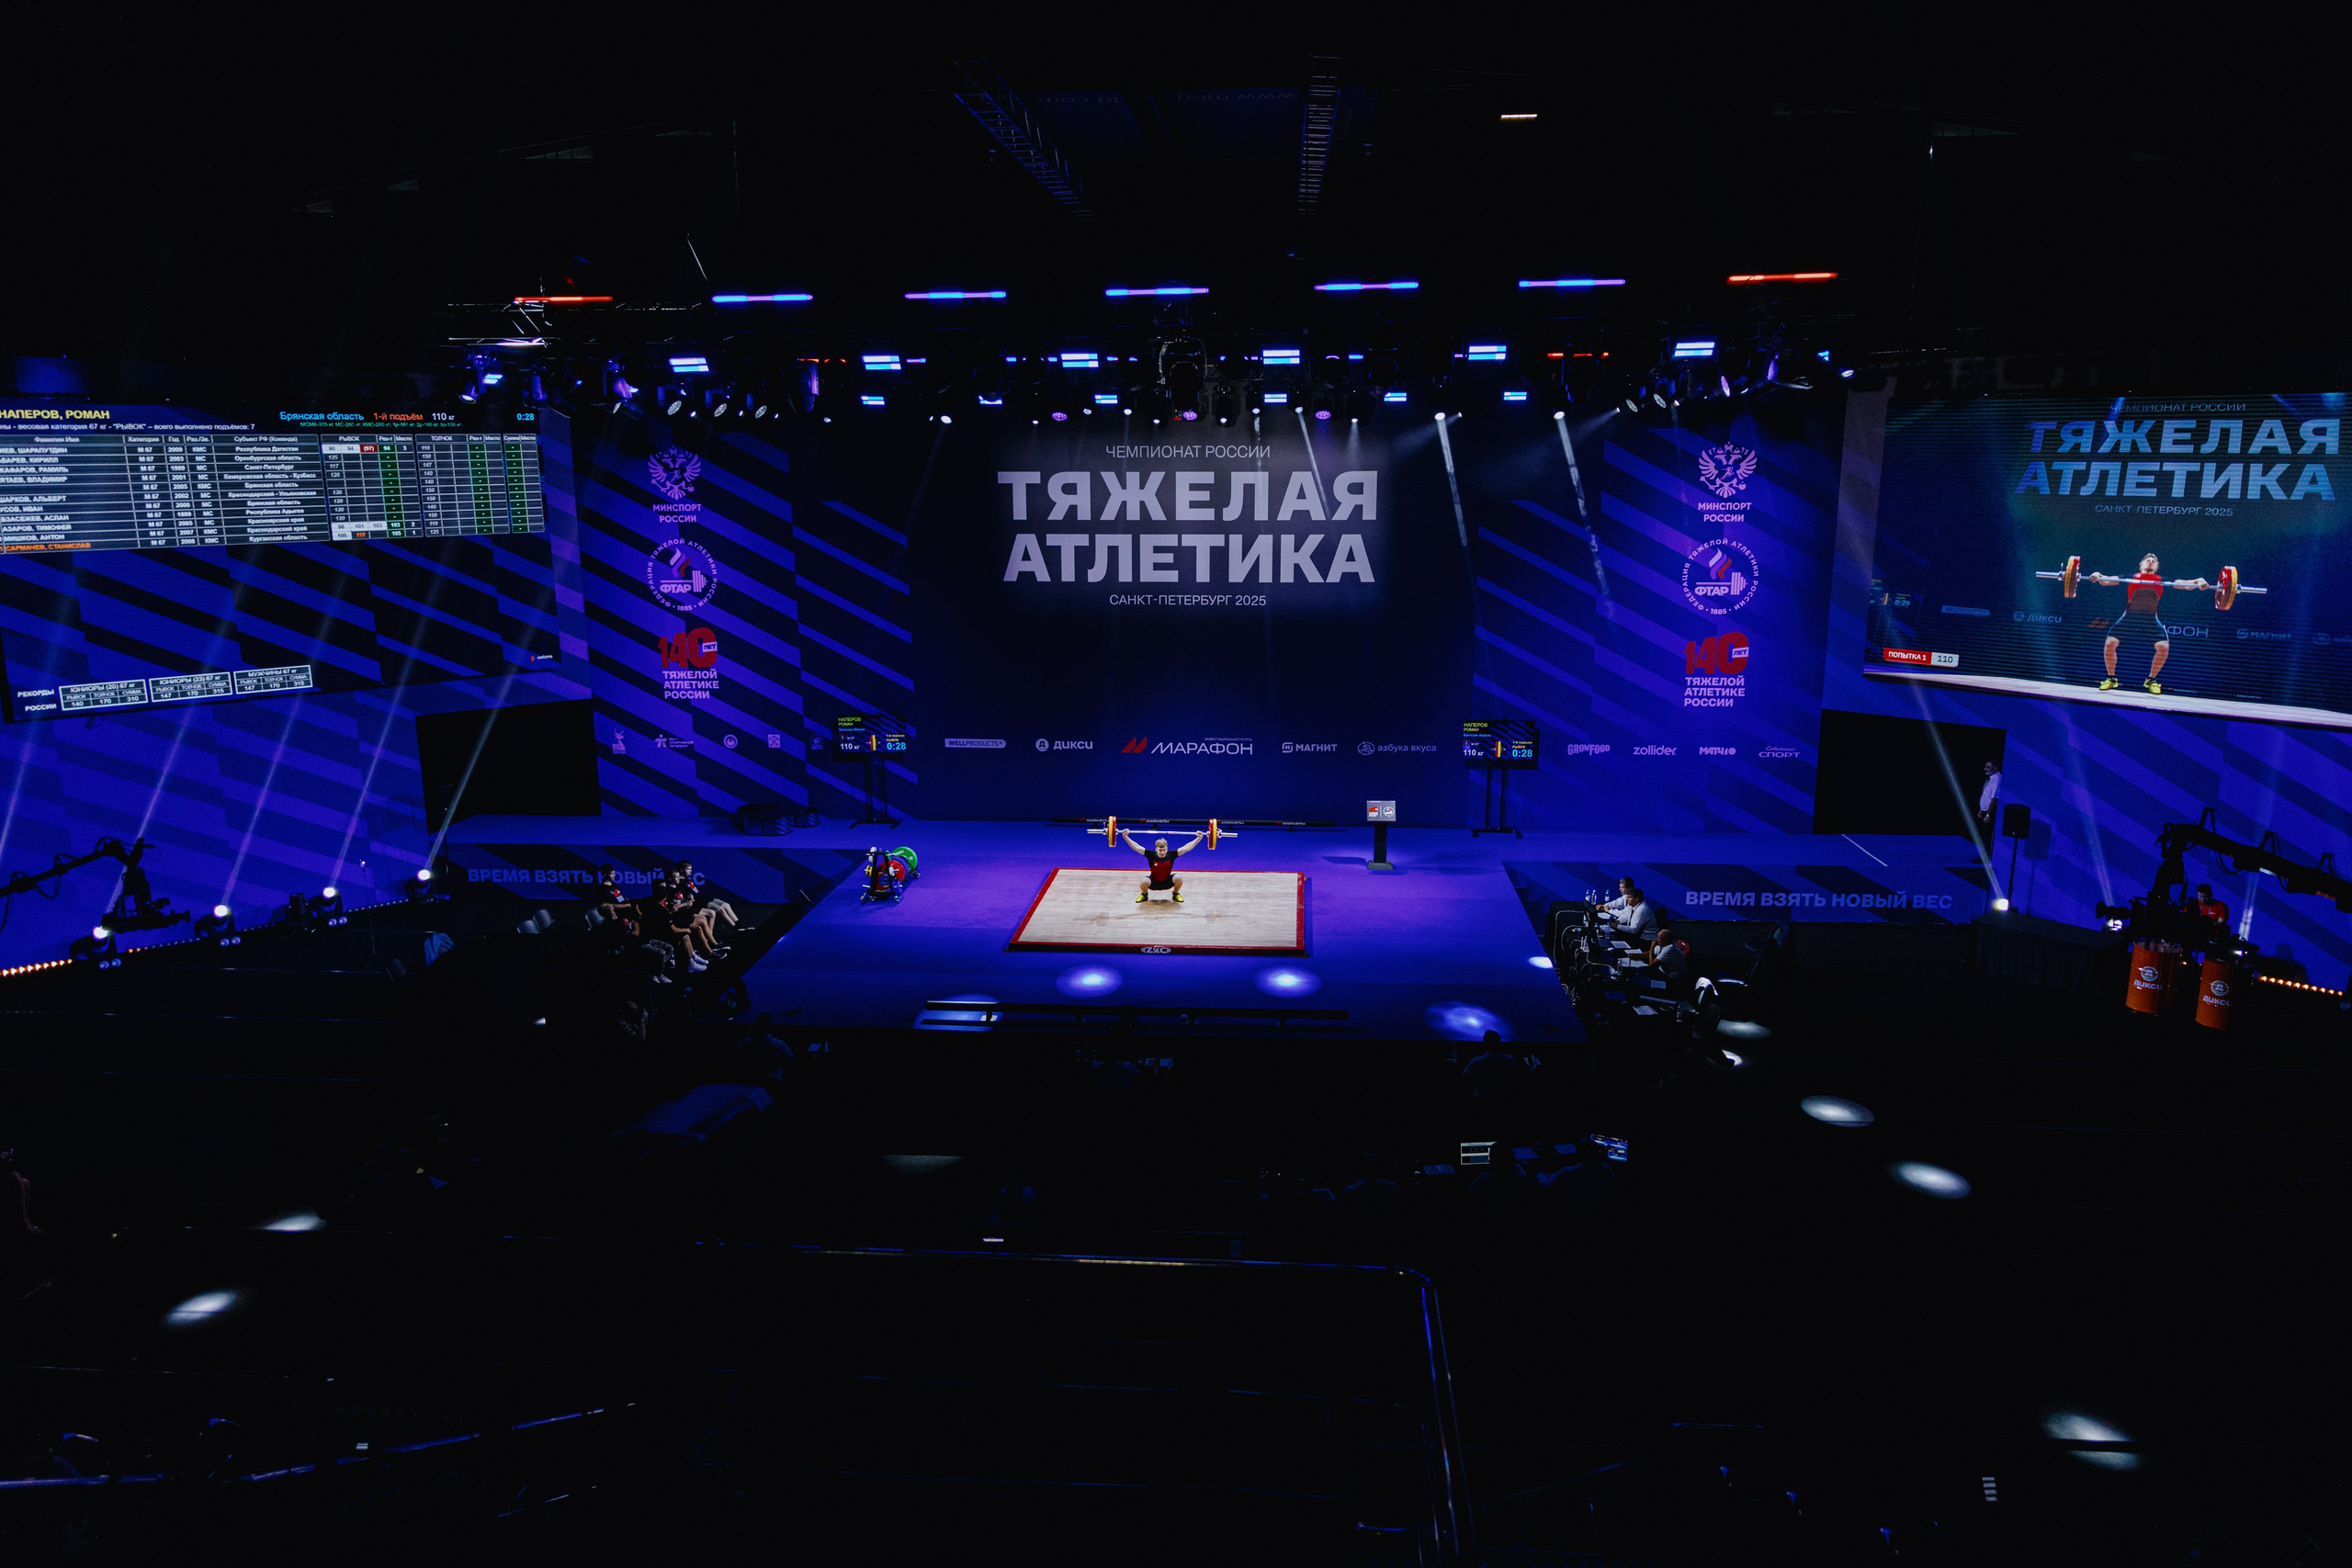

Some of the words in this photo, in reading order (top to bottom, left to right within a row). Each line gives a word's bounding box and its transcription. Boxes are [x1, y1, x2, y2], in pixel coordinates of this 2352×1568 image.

[2190, 402, 2246, 412] РОССИИ
[0, 410, 63, 421] НАПЕРОВ,
[65, 410, 110, 420] РОМАН
[279, 412, 325, 422] Брянская
[326, 412, 365, 421] область
[373, 412, 388, 421] 1-й
[390, 412, 424, 422] подъём
[431, 412, 447, 422] 110
[516, 412, 536, 422] 0:28
[51, 423, 88, 432] категория
[2026, 419, 2340, 455] ТЯЖЕЛАЯ
[1105, 446, 1202, 458] ЧЕМПИОНАТ
[1205, 446, 1271, 458] РОССИИ
[2015, 461, 2336, 501] АТЛЕТИКА
[997, 470, 1378, 521] ТЯЖЕЛАЯ
[652, 503, 702, 513] МИНСПОРТ
[1698, 502, 1752, 511] МИНСПОРТ
[2204, 506, 2233, 517] 2025
[1703, 513, 1745, 523] РОССИИ
[651, 537, 685, 559] ТЯЖЕЛОЙ
[1688, 537, 1728, 560] ТЯЖЕЛОЙ
[687, 540, 718, 575] АТЛЕТИКИ
[1002, 533, 1375, 583] АТЛЕТИКА
[1731, 540, 1759, 577] АТЛЕТИКИ
[647, 561, 672, 607] ФЕДЕРАЦИЯ
[660, 583, 692, 593] ФТАР
[1681, 562, 1704, 611] ФЕДЕРАЦИЯ
[697, 578, 718, 607] РОССИИ
[1694, 586, 1729, 596] ФТАР
[1733, 580, 1758, 611] РОССИИ
[1109, 594, 1232, 606] САНКТ-ПЕТЕРБУРГ
[1235, 594, 1267, 606] 2025
[658, 626, 718, 668] 140
[703, 643, 717, 651] ЛЕТ
[1684, 631, 1749, 674] 140
[1888, 650, 1922, 660] ПОПЫТКА
[1937, 655, 1953, 663] 110
[662, 669, 718, 680] ТЯЖЕЛОЙ
[663, 680, 719, 690] АТЛЕТИКЕ
[1685, 675, 1746, 686] ТЯЖЕЛОЙ
[17, 689, 55, 698] РЕКОРДЫ
[664, 691, 710, 699] РОССИИ
[1684, 687, 1746, 697] АТЛЕТИКЕ
[24, 703, 57, 712] РОССИИ
[1684, 697, 1734, 707] РОССИИ
[887, 742, 907, 750] 0:28
[1150, 741, 1253, 756] МАРАФОН
[1295, 743, 1338, 752] МАГНИТ
[1377, 743, 1408, 753] азбука
[1410, 745, 1437, 753] вкуса
[1567, 743, 1611, 756] GROWFOOD
[1511, 749, 1533, 758] 0:28
[468, 868, 530, 883] ВРЕМЯ
[536, 869, 594, 884] ВЗЯТЬ
[1685, 891, 1756, 907] ВРЕМЯ
[1760, 892, 1826, 908] ВЗЯТЬ
[1832, 890, 1906, 908] НОВЫЙ
[1912, 895, 1953, 909] ВЕС
